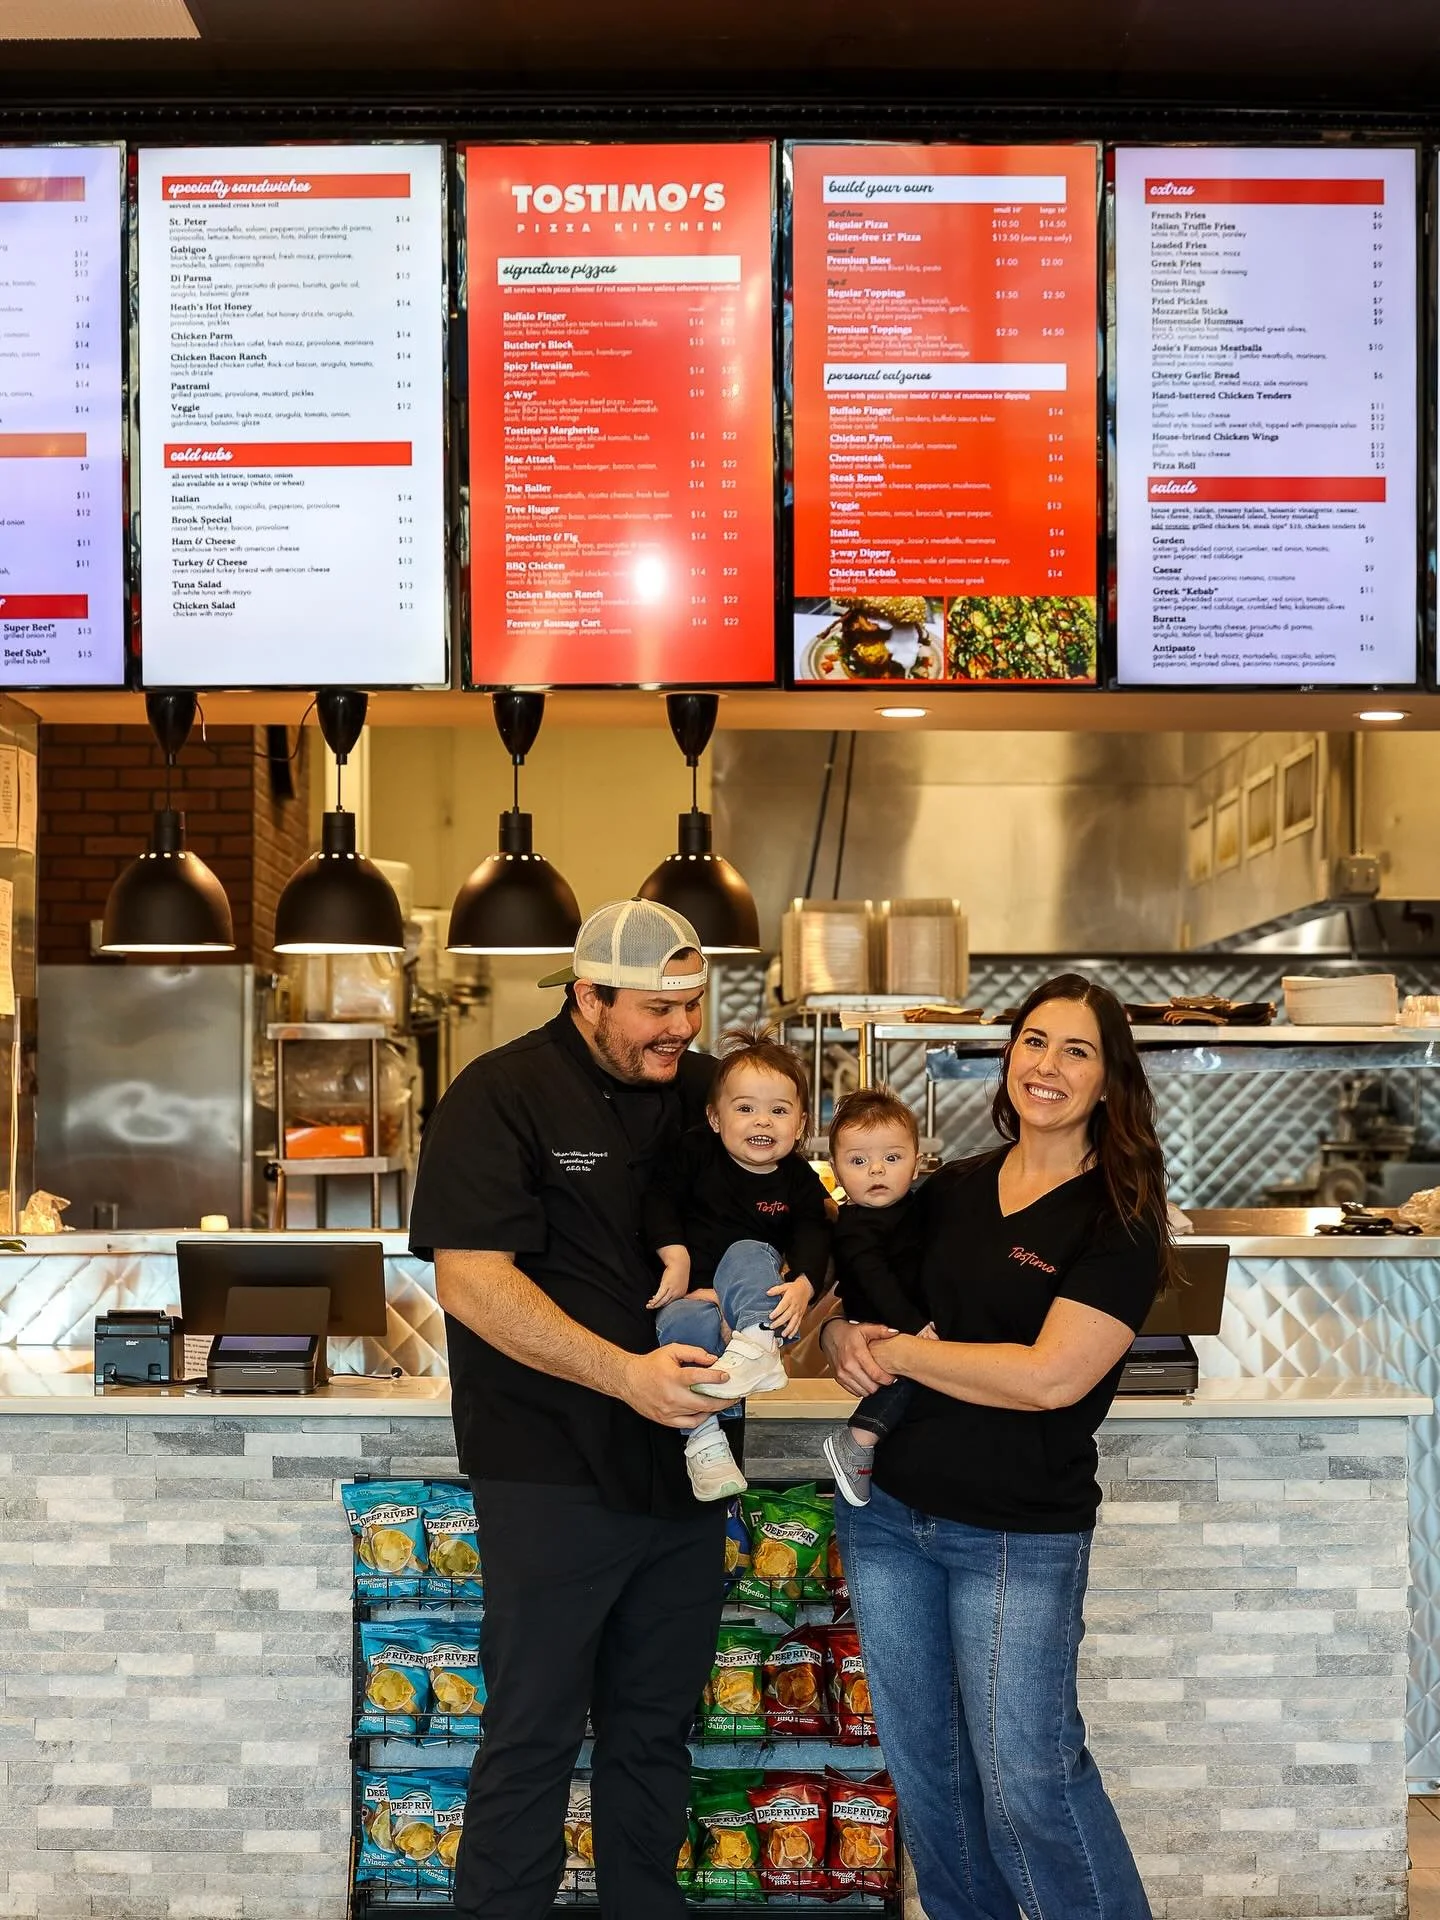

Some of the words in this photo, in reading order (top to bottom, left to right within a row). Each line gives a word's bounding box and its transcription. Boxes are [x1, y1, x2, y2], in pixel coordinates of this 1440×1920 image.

[168, 180, 230, 198] specialty
[231, 178, 311, 193] sandwiches
[829, 181, 865, 192] build
[867, 183, 900, 198] your
[904, 184, 933, 193] own
[1150, 182, 1194, 196] extras
[518, 223, 591, 233] PIZZA
[615, 222, 721, 232] KITCHEN
[828, 220, 862, 230] Regular
[865, 220, 888, 228] Pizza
[992, 220, 1019, 228] $10.50
[1040, 220, 1066, 228] $14.50
[828, 233, 880, 242] Gluten-free
[898, 233, 920, 241] Pizza
[827, 256, 868, 264] Premium
[871, 256, 891, 264] Base
[503, 262, 570, 280] signature
[571, 262, 616, 278] pizzas
[828, 289, 862, 299] Regular
[864, 289, 905, 299] Toppings
[224, 303, 252, 313] Honey
[504, 312, 534, 320] Buffalo
[538, 312, 566, 322] Finger
[828, 325, 868, 334] Premium
[871, 325, 912, 336] Toppings
[504, 362, 528, 372] Spicy
[531, 362, 572, 370] Hawaiian
[827, 370, 880, 384] personal
[883, 370, 931, 384] calzones
[1152, 372, 1182, 380] Cheesy
[171, 404, 200, 413] Veggie
[504, 426, 548, 434] Tostimo's
[550, 426, 599, 436] Margherita
[1252, 433, 1279, 442] Wings
[171, 448, 200, 461] cold
[201, 448, 233, 461] subs
[829, 454, 883, 462] Cheesesteak
[830, 474, 854, 482] Steak
[857, 474, 883, 482] Bomb
[1151, 480, 1197, 494] salads
[528, 505, 560, 515] Hugger
[830, 502, 860, 511] Veggie
[201, 516, 232, 525] Special
[830, 529, 859, 537] Italian
[506, 534, 551, 542] Prosciutto
[564, 534, 578, 543] Fig
[830, 549, 858, 558] 3-way
[860, 549, 891, 558] Dipper
[1050, 549, 1064, 557] $19
[173, 559, 203, 568] Turkey
[506, 562, 526, 571] BBQ
[829, 569, 866, 577] Chicken
[868, 568, 896, 577] Kebab
[507, 620, 541, 629] Fenway
[544, 620, 579, 629] Sausage
[692, 618, 706, 626] $14
[724, 618, 738, 626] $22
[4, 624, 30, 633] Super
[1153, 644, 1195, 653] Antipasto
[756, 1200, 788, 1216] Tosti
[361, 1512, 382, 1526] DEEP
[384, 1508, 415, 1518] RIVER
[426, 1521, 450, 1530] DEEP
[765, 1524, 787, 1536] DEEP
[787, 1530, 815, 1542] RIVER
[424, 1654, 444, 1663] DEEP
[444, 1653, 476, 1662] RIVER
[768, 1652, 792, 1662] DEEP
[794, 1650, 820, 1663] RIVER
[391, 1802, 413, 1811] DEEP
[758, 1808, 783, 1819] DEEP
[785, 1807, 816, 1817] RIVER
[834, 1805, 859, 1814] DEEP
[860, 1808, 888, 1819] RIVER
[438, 1814, 460, 1822] DEEP
